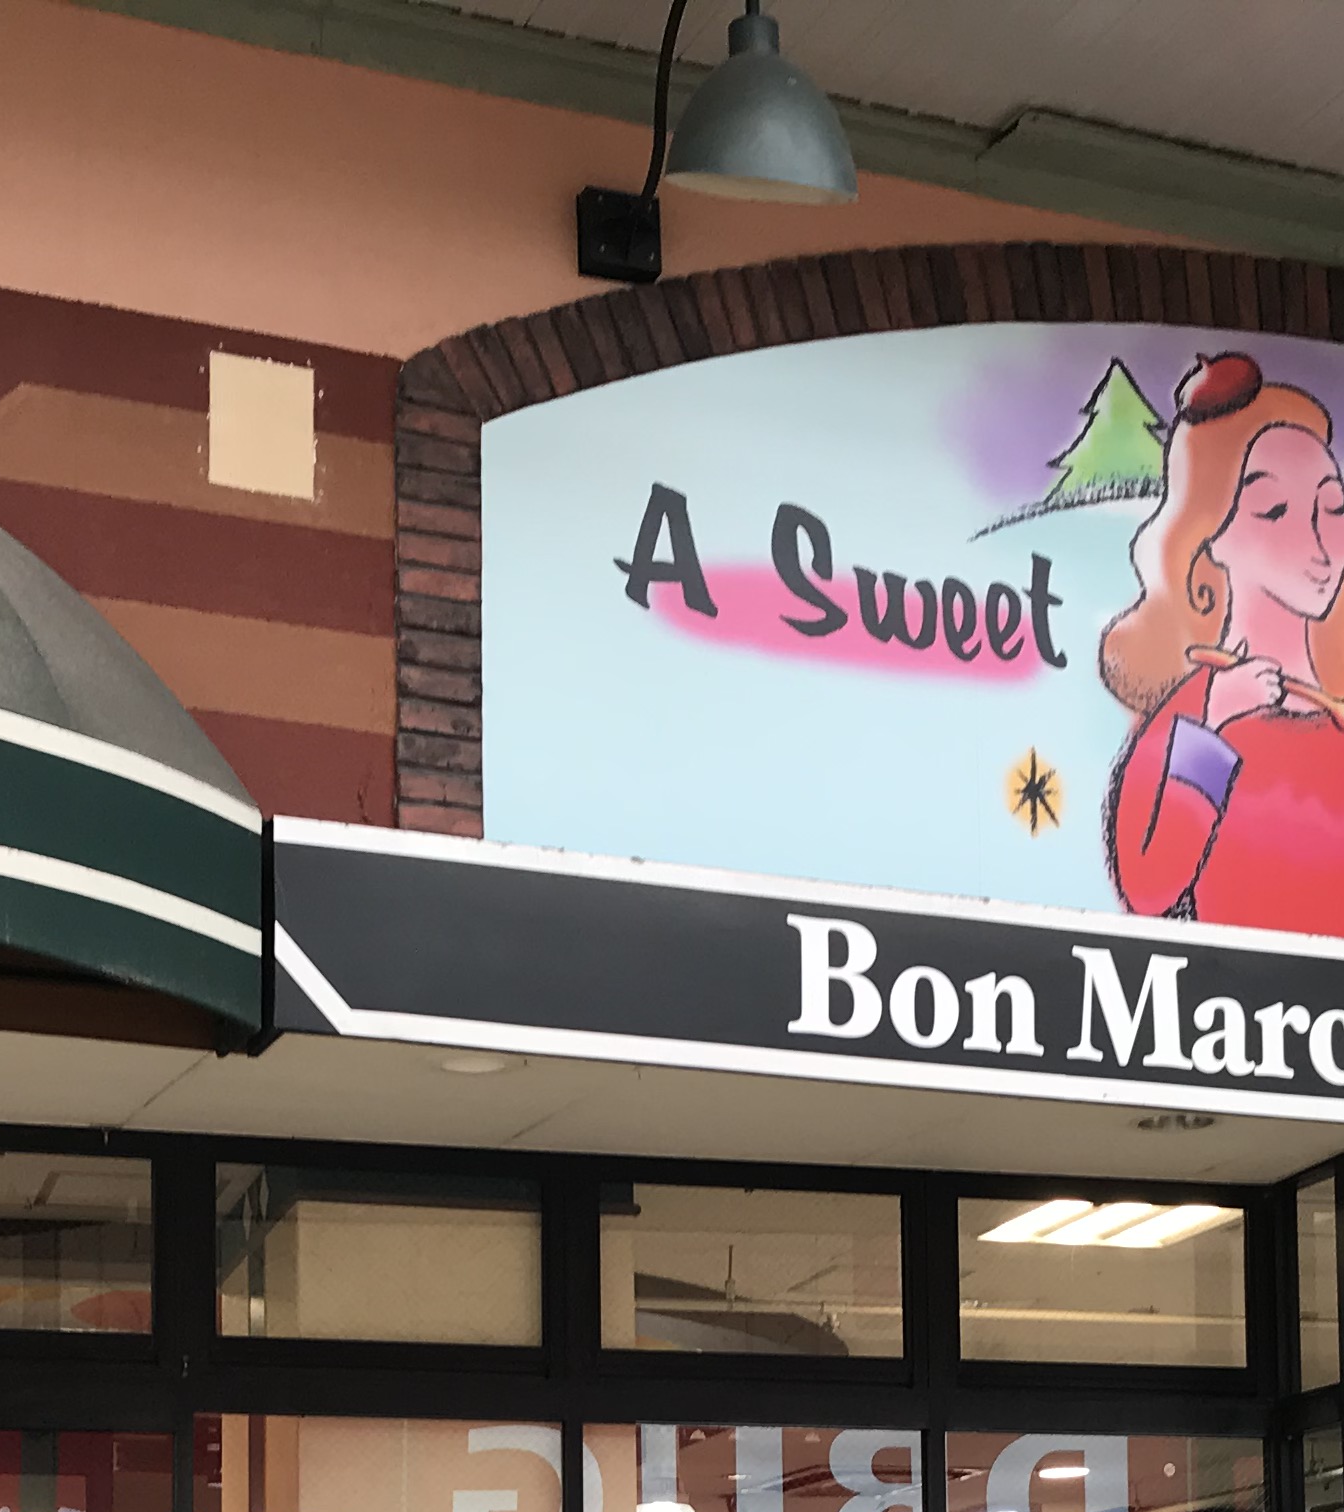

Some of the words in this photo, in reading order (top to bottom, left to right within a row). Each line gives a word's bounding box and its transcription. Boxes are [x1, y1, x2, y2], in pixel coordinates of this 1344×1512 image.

[613, 482, 718, 619] A
[771, 502, 1067, 669] Sweet
[787, 913, 1044, 1057] Bon
